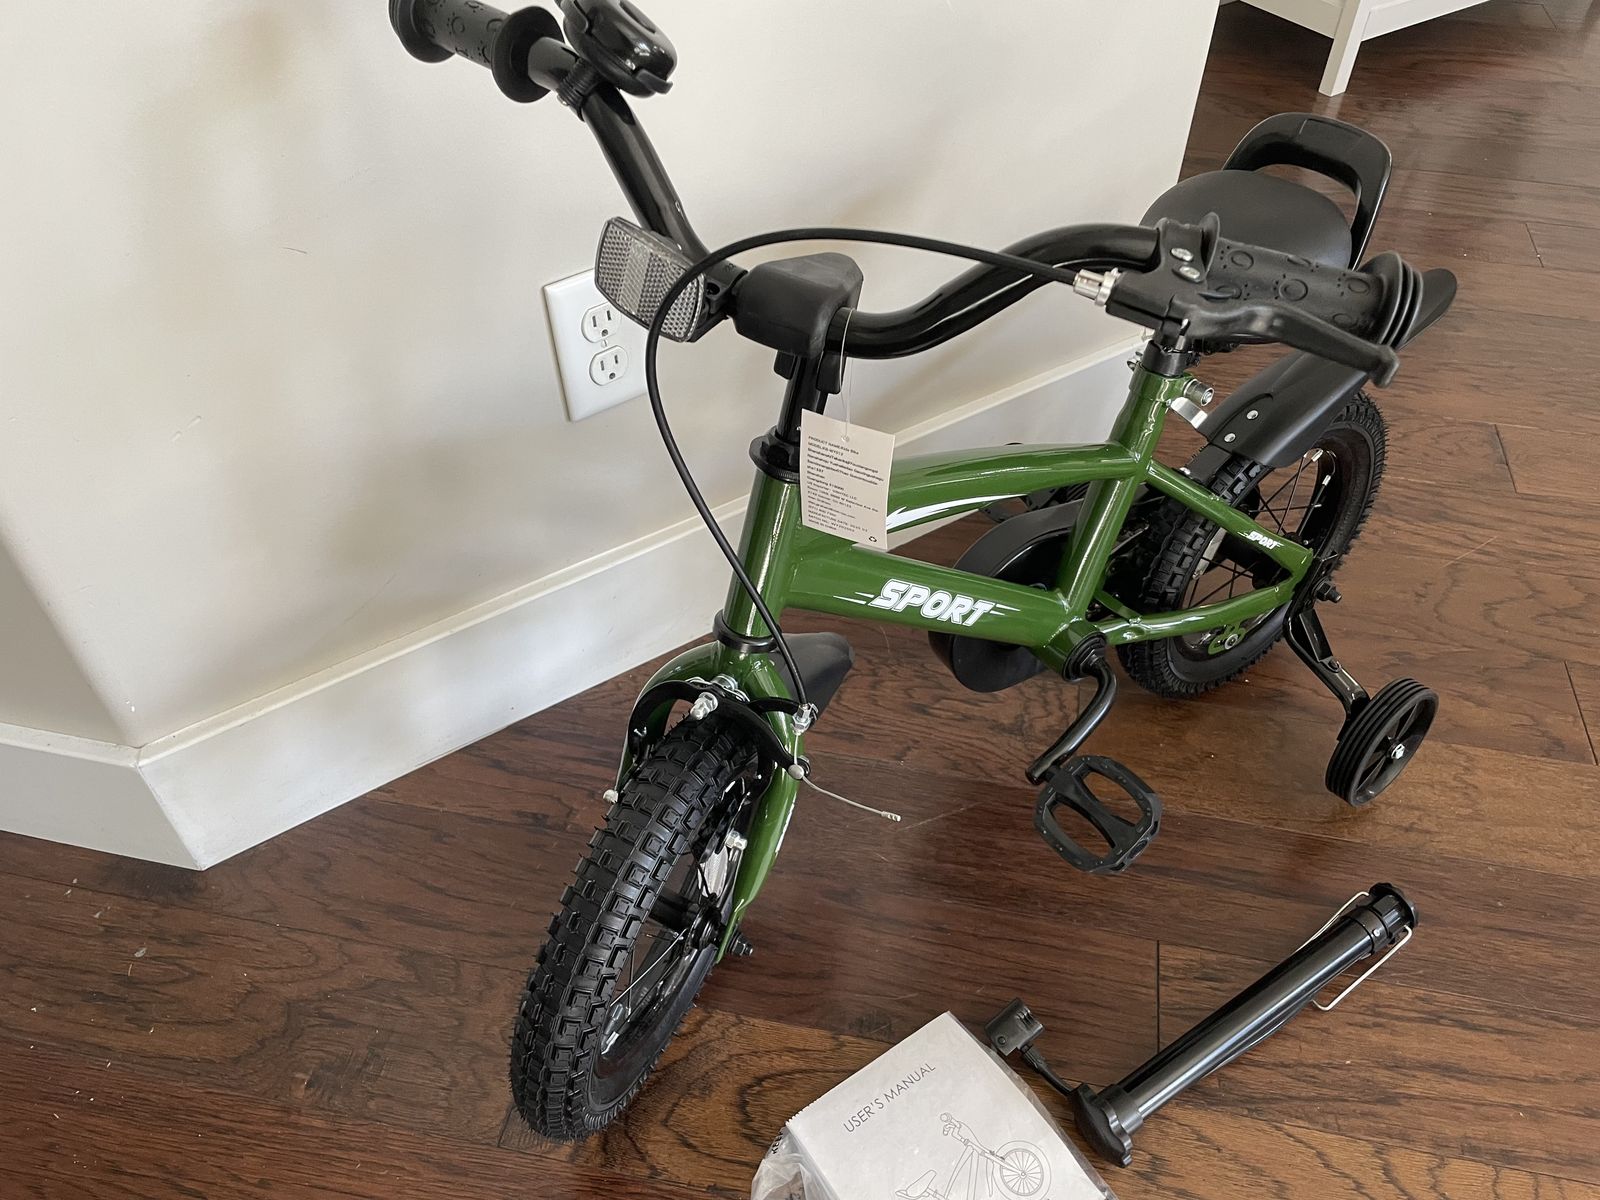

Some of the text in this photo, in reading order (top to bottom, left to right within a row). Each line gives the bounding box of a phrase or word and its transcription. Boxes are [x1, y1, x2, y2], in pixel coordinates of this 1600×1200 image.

[1246, 531, 1279, 550] SPORT
[868, 578, 996, 627] SPORT
[843, 1062, 936, 1133] USER'S MANUAL
